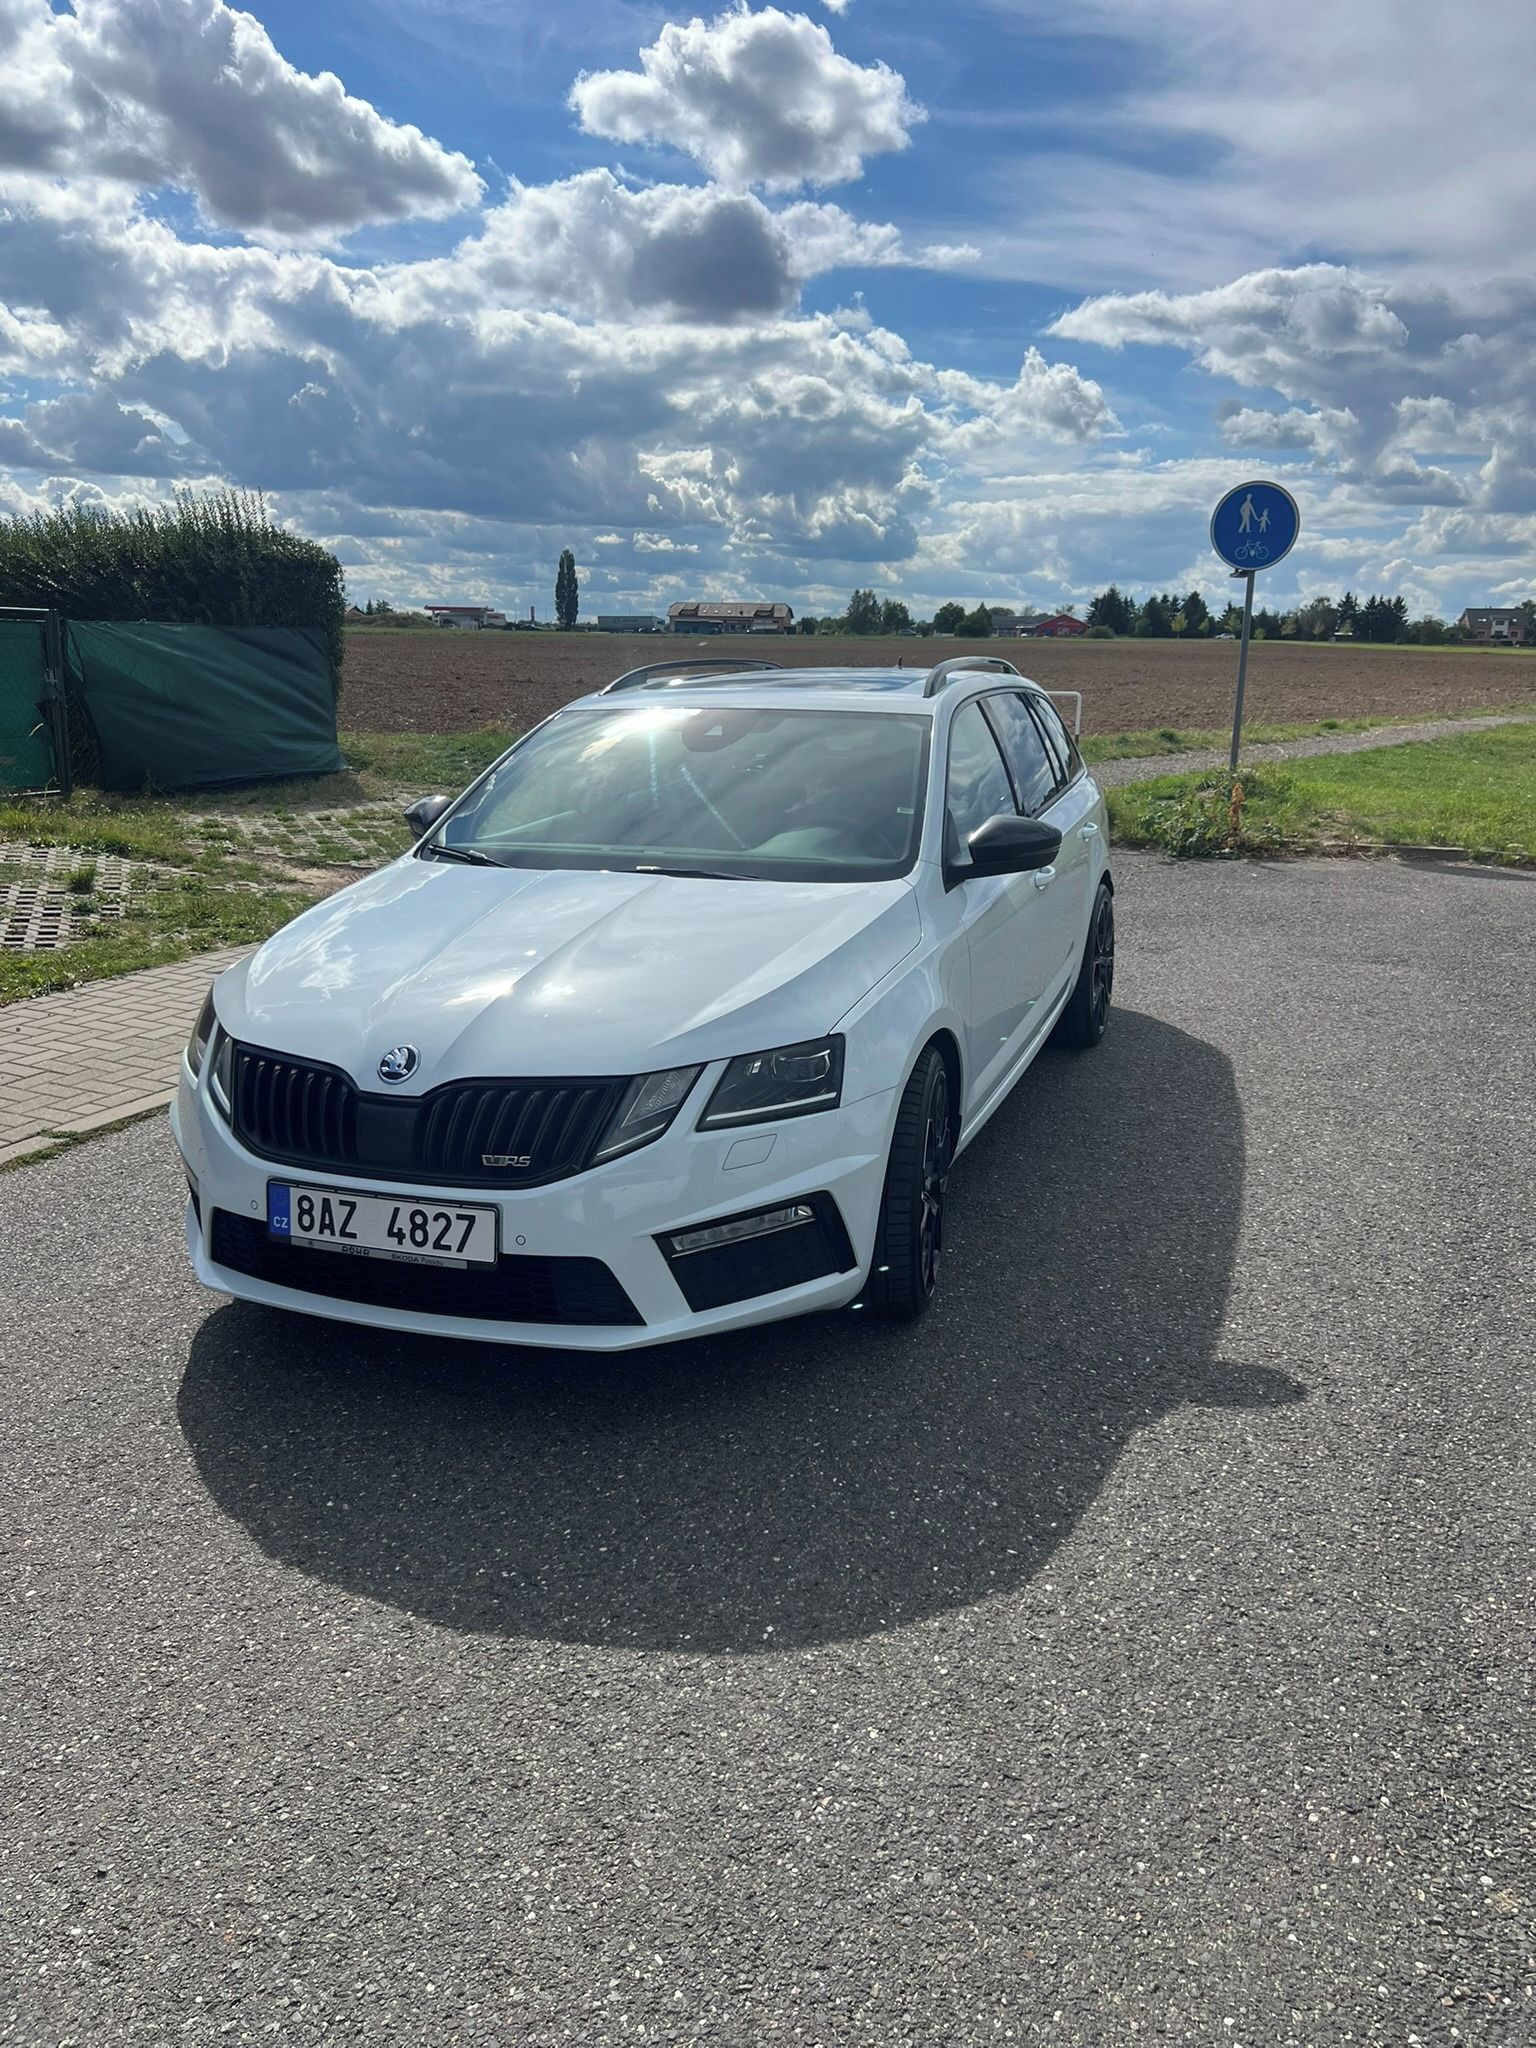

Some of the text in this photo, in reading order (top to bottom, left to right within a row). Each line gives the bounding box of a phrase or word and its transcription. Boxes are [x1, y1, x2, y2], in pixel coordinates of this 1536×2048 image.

[273, 1216, 289, 1229] CZ
[297, 1194, 477, 1254] 8AZ 4827
